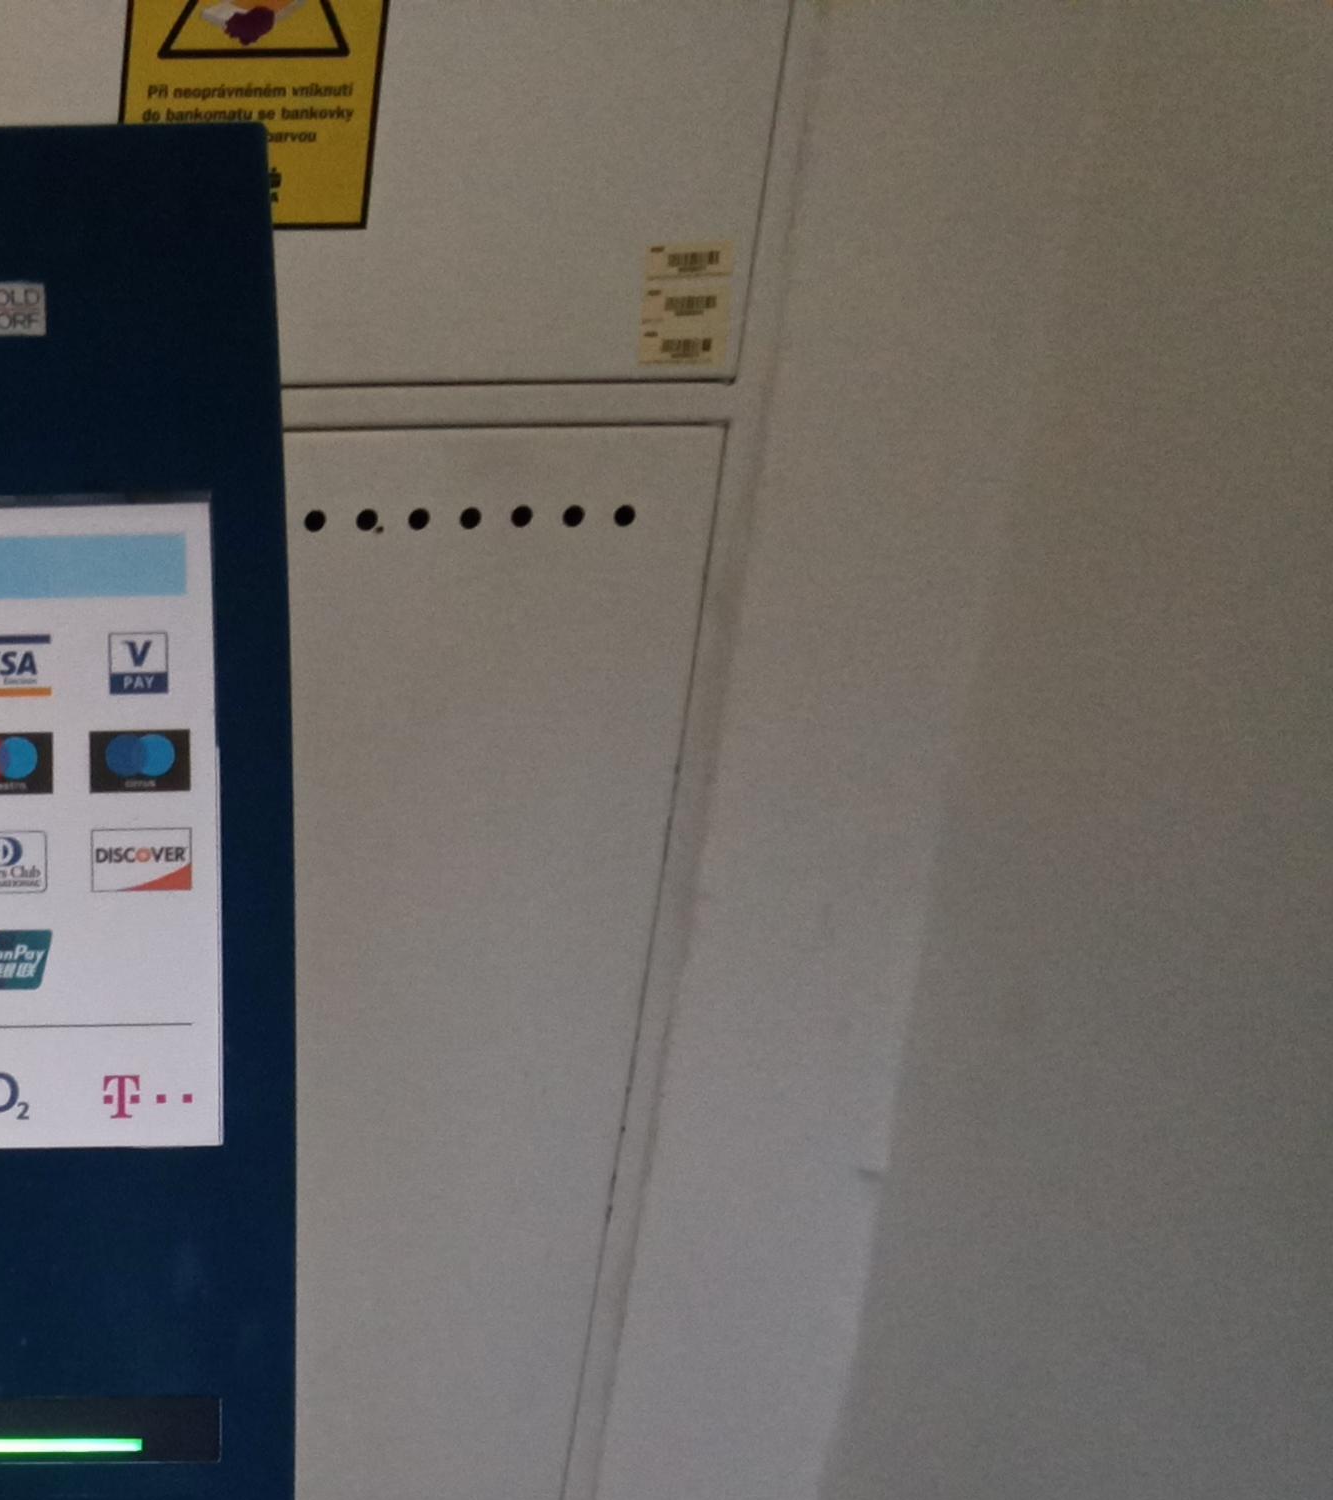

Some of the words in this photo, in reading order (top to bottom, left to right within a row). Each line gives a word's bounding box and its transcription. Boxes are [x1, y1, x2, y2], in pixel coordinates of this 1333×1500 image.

[142, 108, 161, 122] do
[165, 107, 254, 122] bankomatu
[258, 108, 276, 121] se
[281, 106, 354, 123] bankovky
[122, 639, 153, 667] V
[122, 674, 156, 690] PAY
[95, 845, 187, 864] DISCOVER
[9, 865, 42, 879] Club
